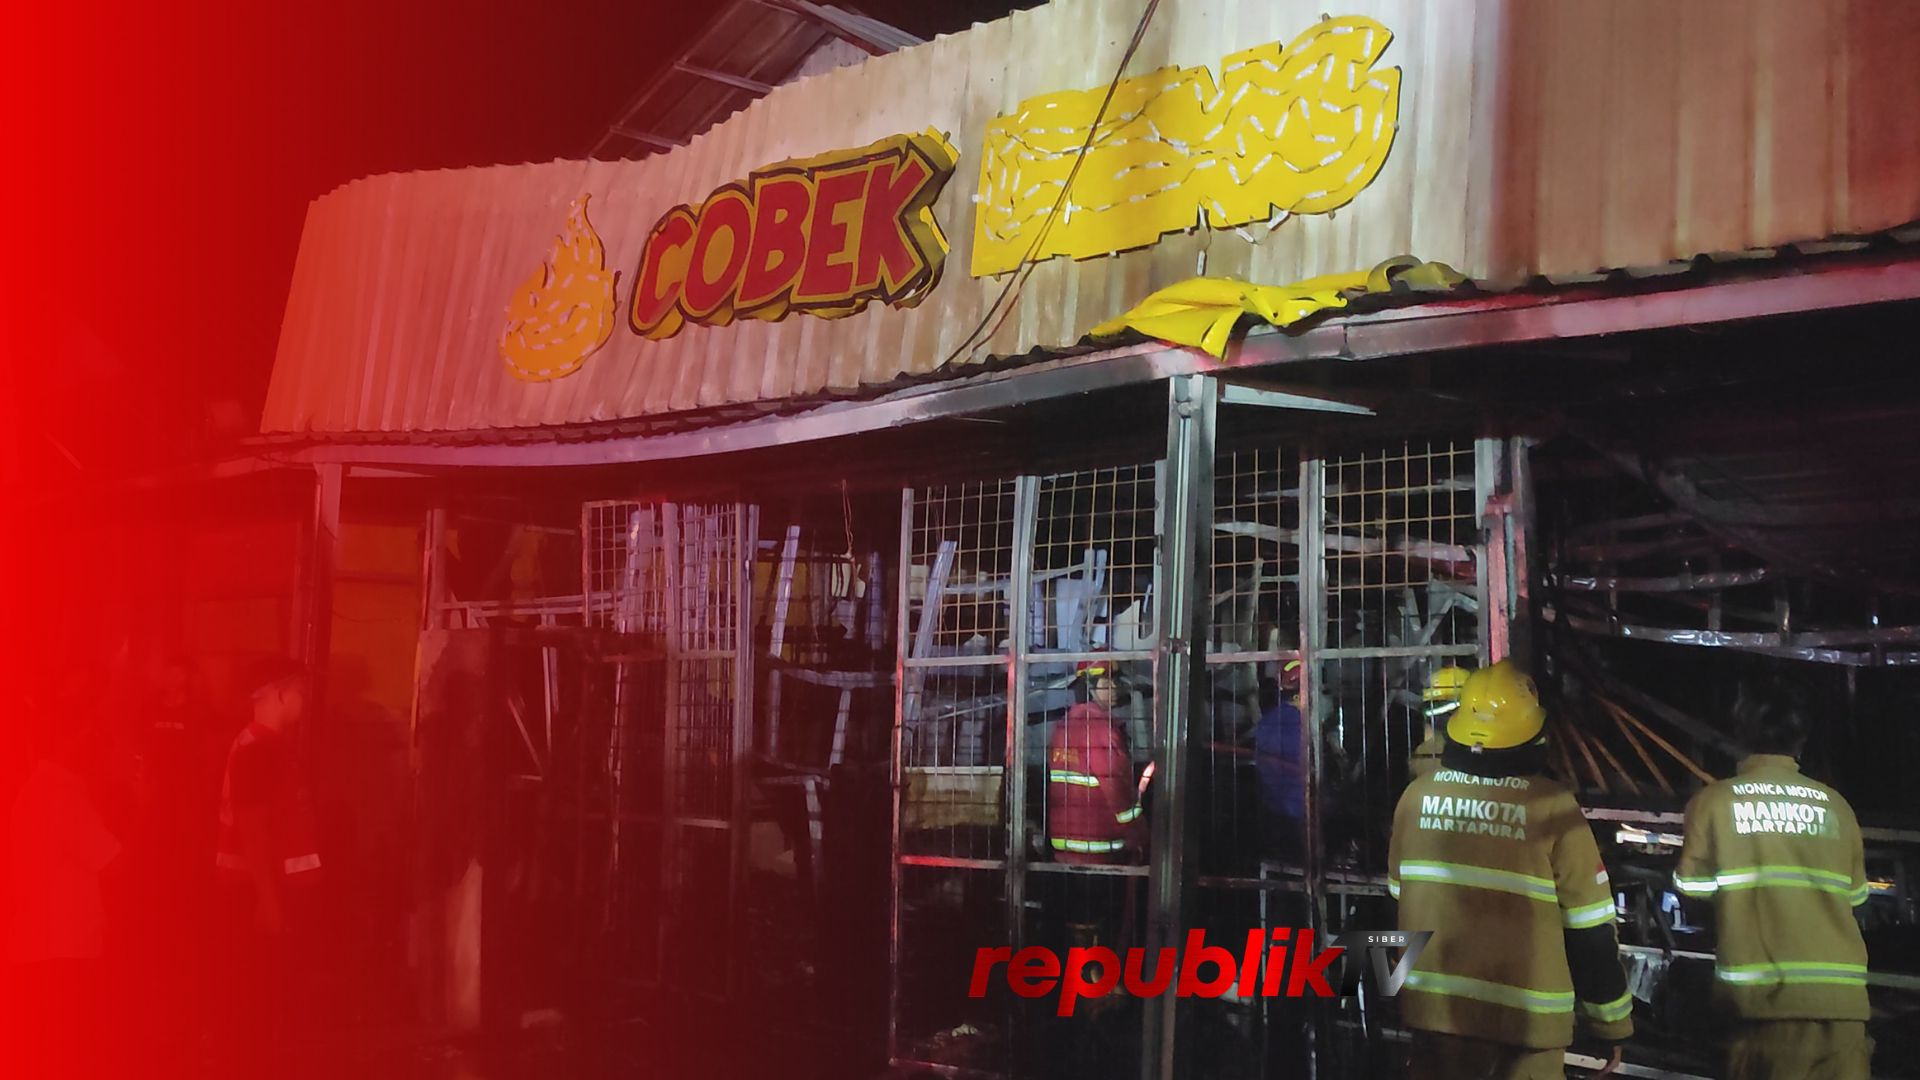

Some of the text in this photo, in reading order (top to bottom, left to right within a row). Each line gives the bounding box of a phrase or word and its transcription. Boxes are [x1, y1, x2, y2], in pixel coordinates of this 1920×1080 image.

[633, 148, 932, 329] COBEK
[1433, 770, 1480, 785] MONICA
[1732, 783, 1830, 801] MONICA MOTOR
[1421, 795, 1527, 825] MAHKOTA
[1419, 817, 1526, 840] MARTAPURA
